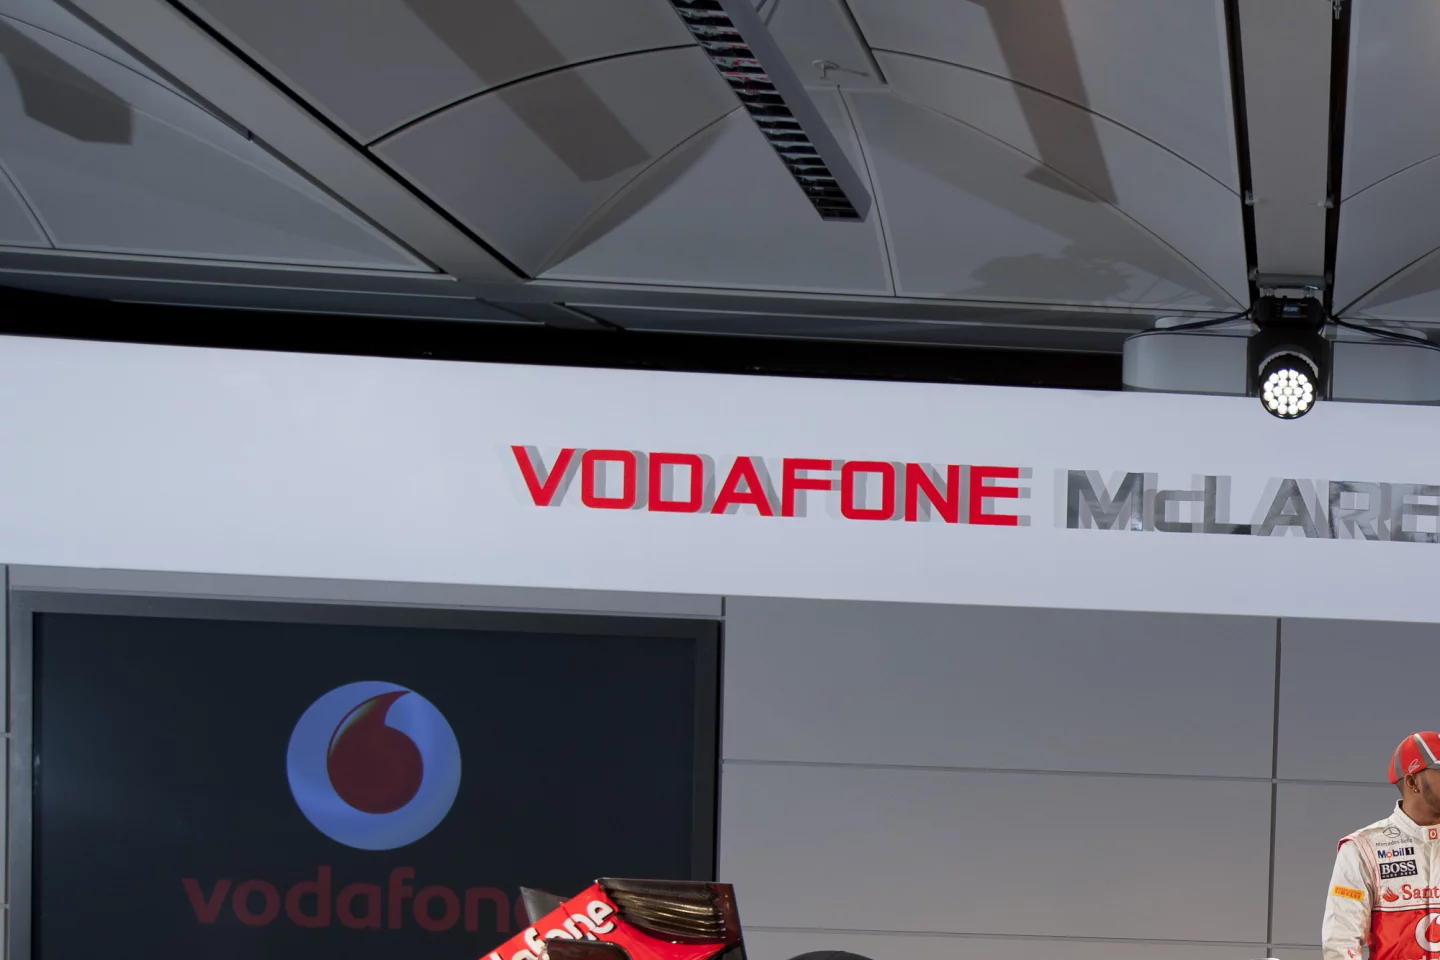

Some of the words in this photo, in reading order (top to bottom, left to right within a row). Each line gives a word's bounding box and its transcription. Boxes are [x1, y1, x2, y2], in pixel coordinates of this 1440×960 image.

[511, 445, 1020, 527] VODAFONE
[1377, 847, 1405, 859] Mobil
[1381, 861, 1416, 875] BOSS
